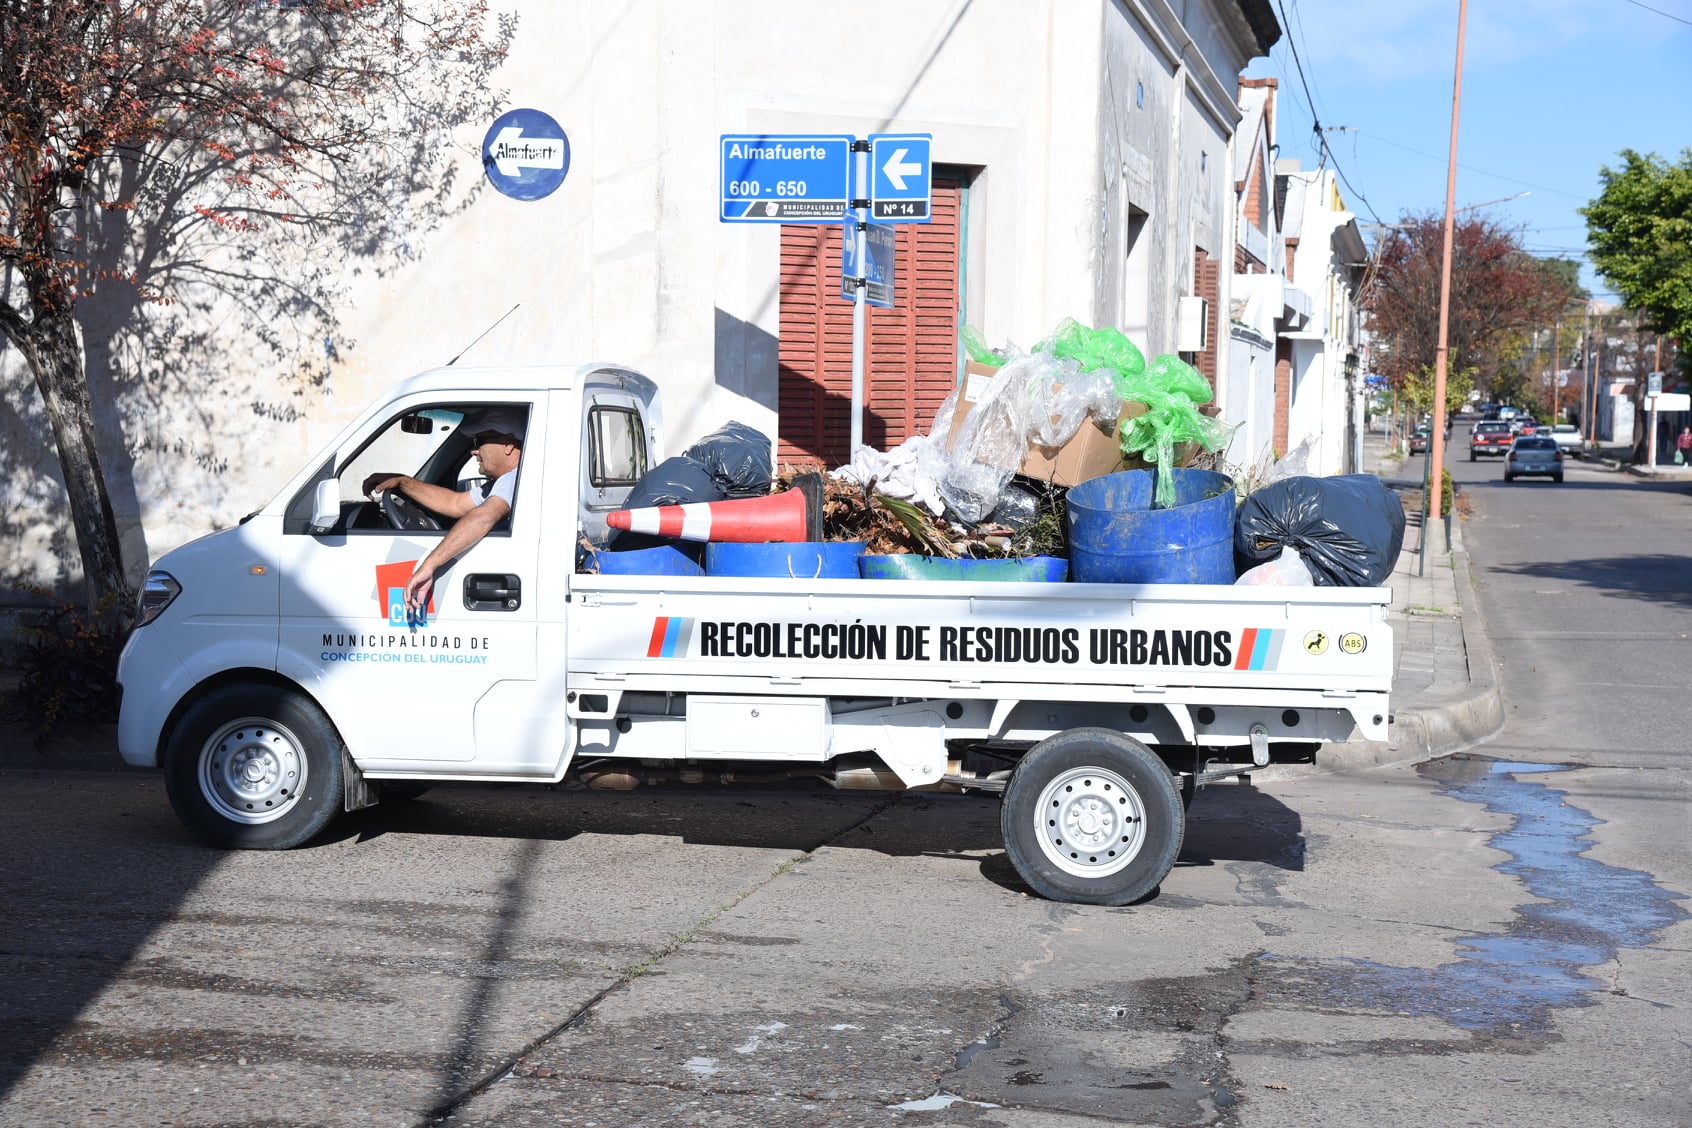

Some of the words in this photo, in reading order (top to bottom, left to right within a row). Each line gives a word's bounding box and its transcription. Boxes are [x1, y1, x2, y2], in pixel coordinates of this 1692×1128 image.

[729, 143, 826, 160] Almafuerte
[729, 180, 760, 196] 600
[776, 180, 807, 196] 650
[901, 203, 914, 215] 14
[322, 633, 461, 649] MUNICIPALIDAD
[471, 637, 489, 650] DE
[700, 618, 887, 660] RECOLECCIÓN
[896, 625, 931, 661] DE
[939, 626, 1080, 665] RESIDUOS
[1089, 628, 1232, 667] URBANOS
[1344, 639, 1361, 648] ABS
[320, 651, 401, 663] CONCEPCIÓN
[404, 654, 426, 663] DEL
[430, 655, 488, 665] URUGUAY
